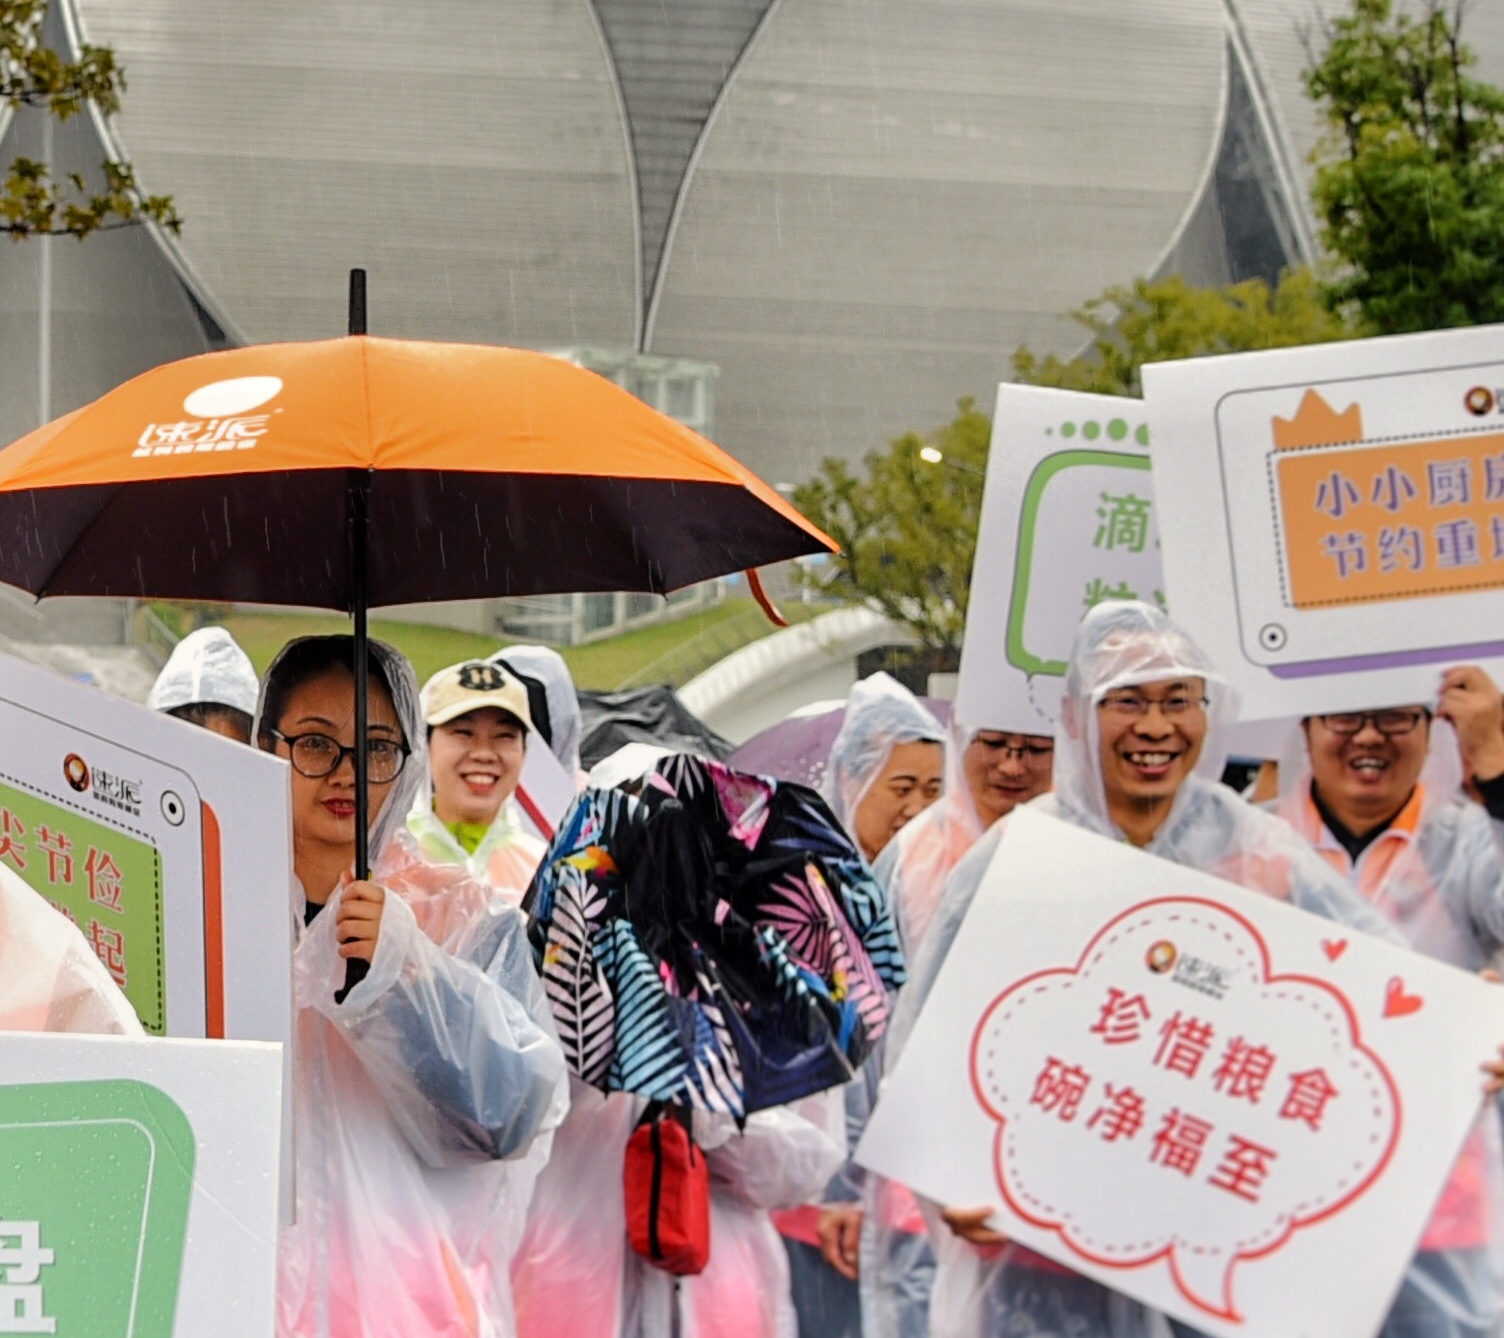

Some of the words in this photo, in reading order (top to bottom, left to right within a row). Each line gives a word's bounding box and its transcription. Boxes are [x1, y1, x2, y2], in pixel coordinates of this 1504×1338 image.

[1027, 1056, 1278, 1204] 碗净福至
[1088, 987, 1340, 1133] 珍惜粮食
